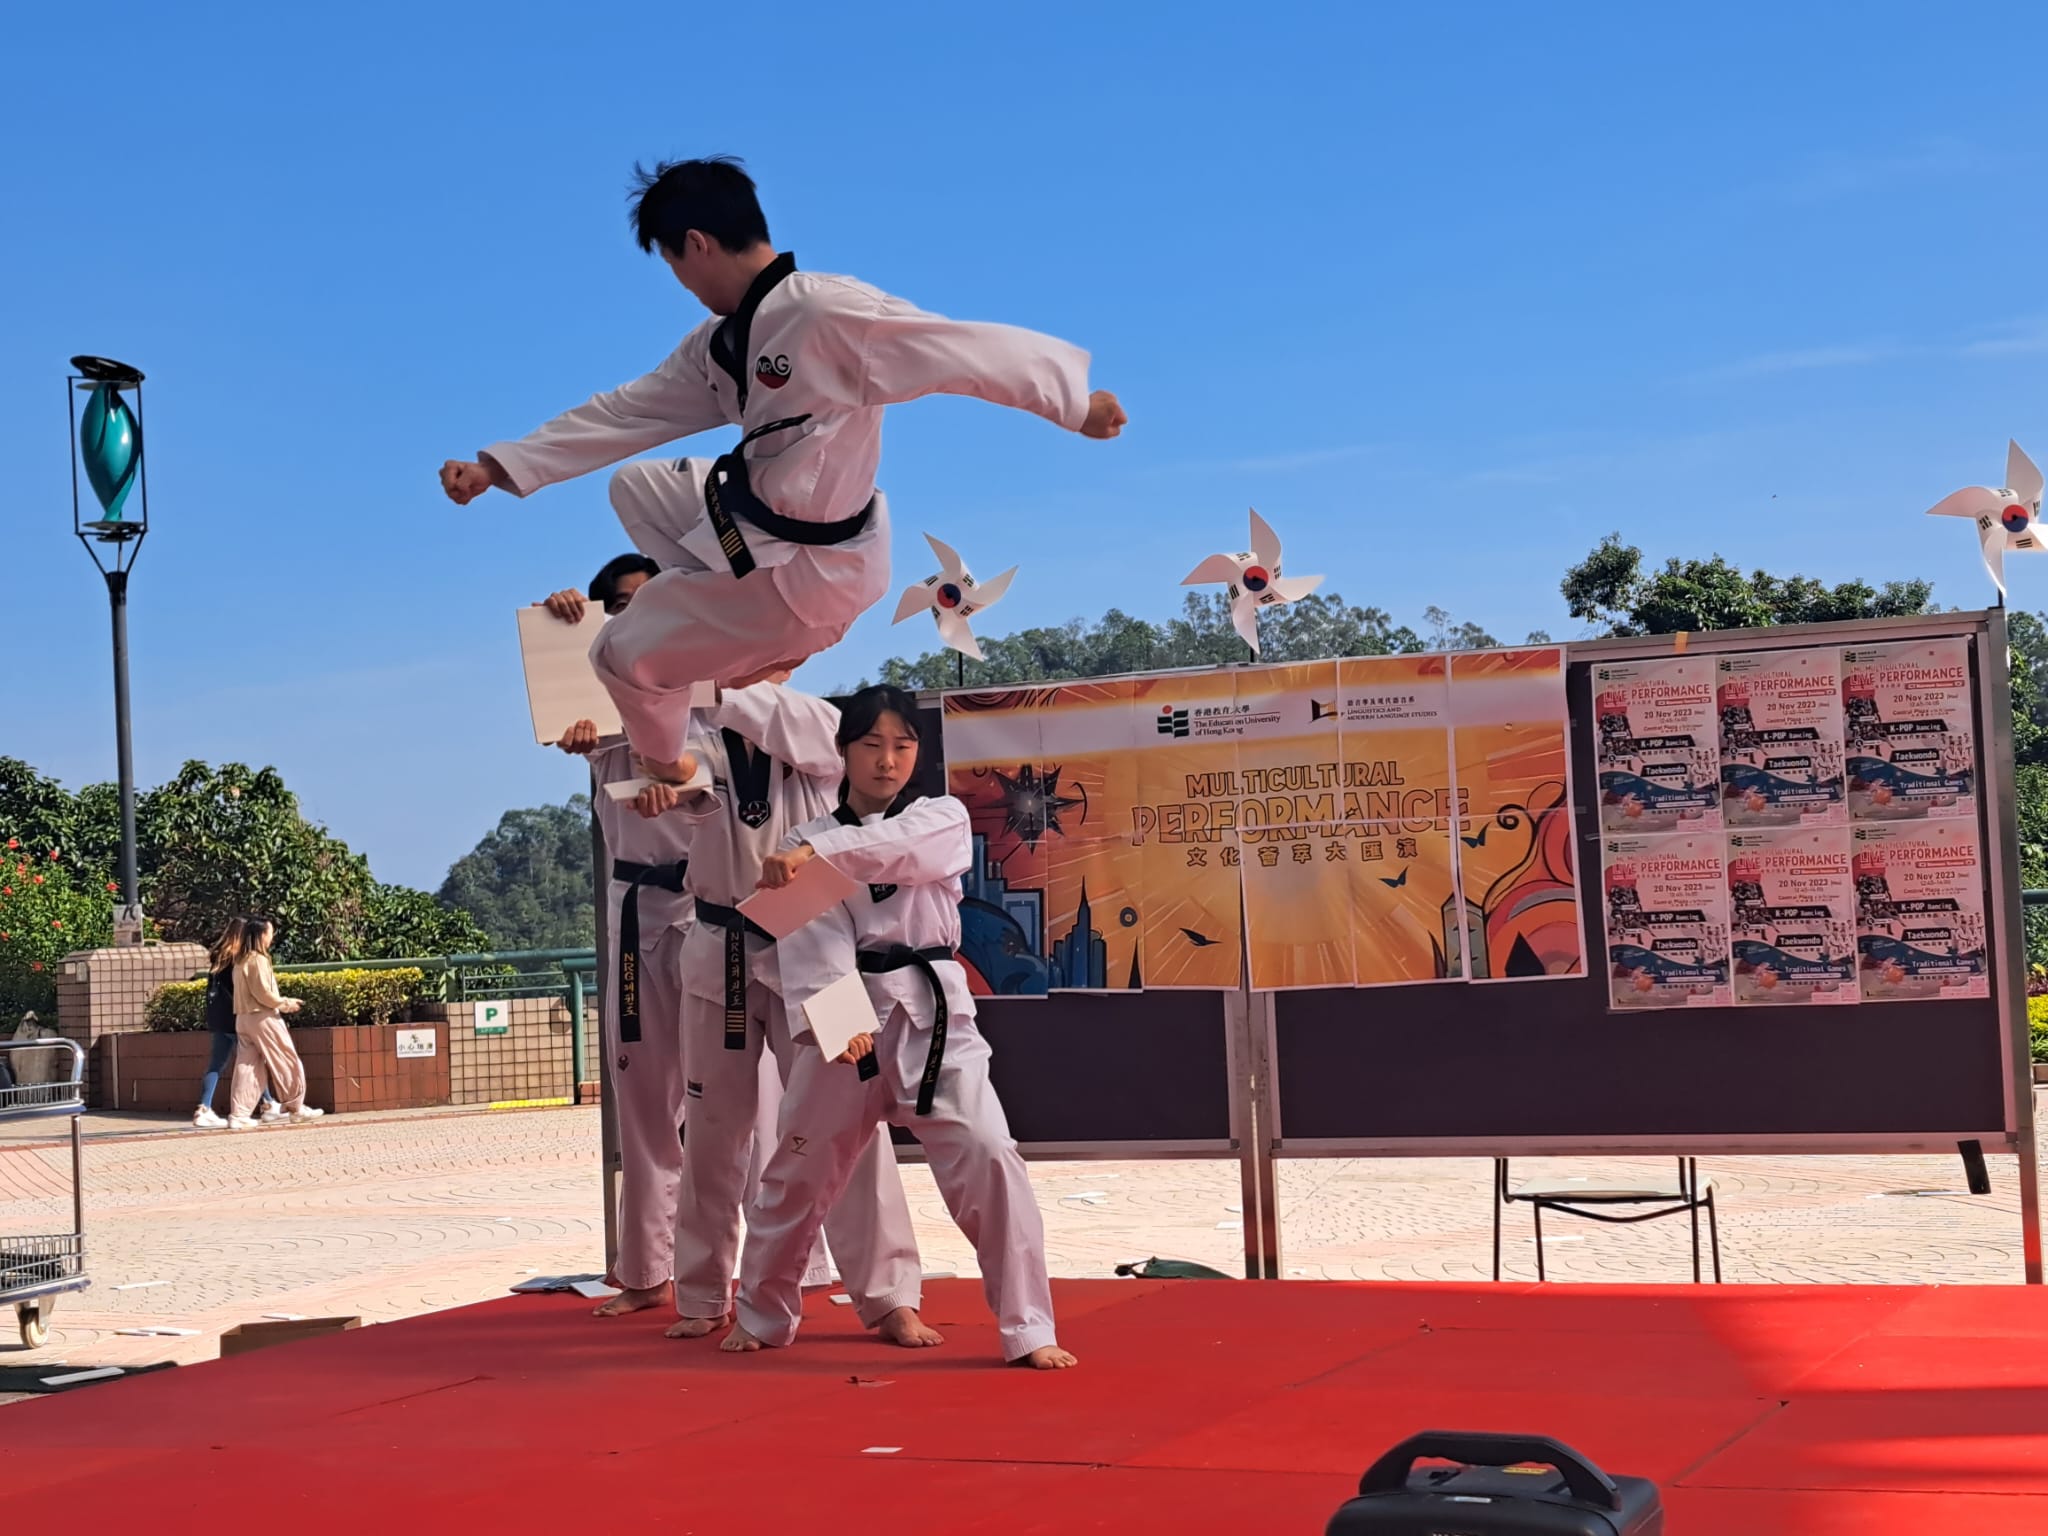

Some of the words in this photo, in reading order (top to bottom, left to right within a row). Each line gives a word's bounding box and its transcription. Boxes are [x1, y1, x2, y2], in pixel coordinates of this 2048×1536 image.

[1880, 667, 1963, 682] PERFORMANCE
[1754, 676, 1834, 690] PERFORMANCE
[1632, 684, 1710, 699] PERFORMANCE
[1767, 703, 1776, 711] 20
[1779, 702, 1795, 710] Nov
[1645, 711, 1653, 719] 20
[1194, 720, 1207, 728] The
[1245, 715, 1281, 725] University
[1203, 728, 1222, 736] Hong
[1890, 724, 1913, 732] K-POP
[1896, 751, 1936, 760] Taekwondo
[1769, 759, 1808, 768] Taekwondo
[1646, 766, 1685, 774] Taekwondo
[1186, 761, 1404, 798] MULTICULTURAL
[1900, 780, 1940, 788] Traditional
[1773, 787, 1812, 796] Traditional
[1651, 793, 1688, 801] Traditional
[1132, 788, 1470, 846] PERFORMANCE
[1890, 846, 1974, 860] PERFORMANCE
[1766, 854, 1847, 867] PERFORMANCE
[1642, 859, 1720, 872] PERFORMANCE
[1901, 903, 1925, 911] K-POP
[1776, 909, 1798, 917] K-POP
[1907, 930, 1948, 939] Taekwondo
[1656, 940, 1696, 949] Taekwondo
[1781, 937, 1821, 945] Taekwondo
[486, 1008, 498, 1022] P
